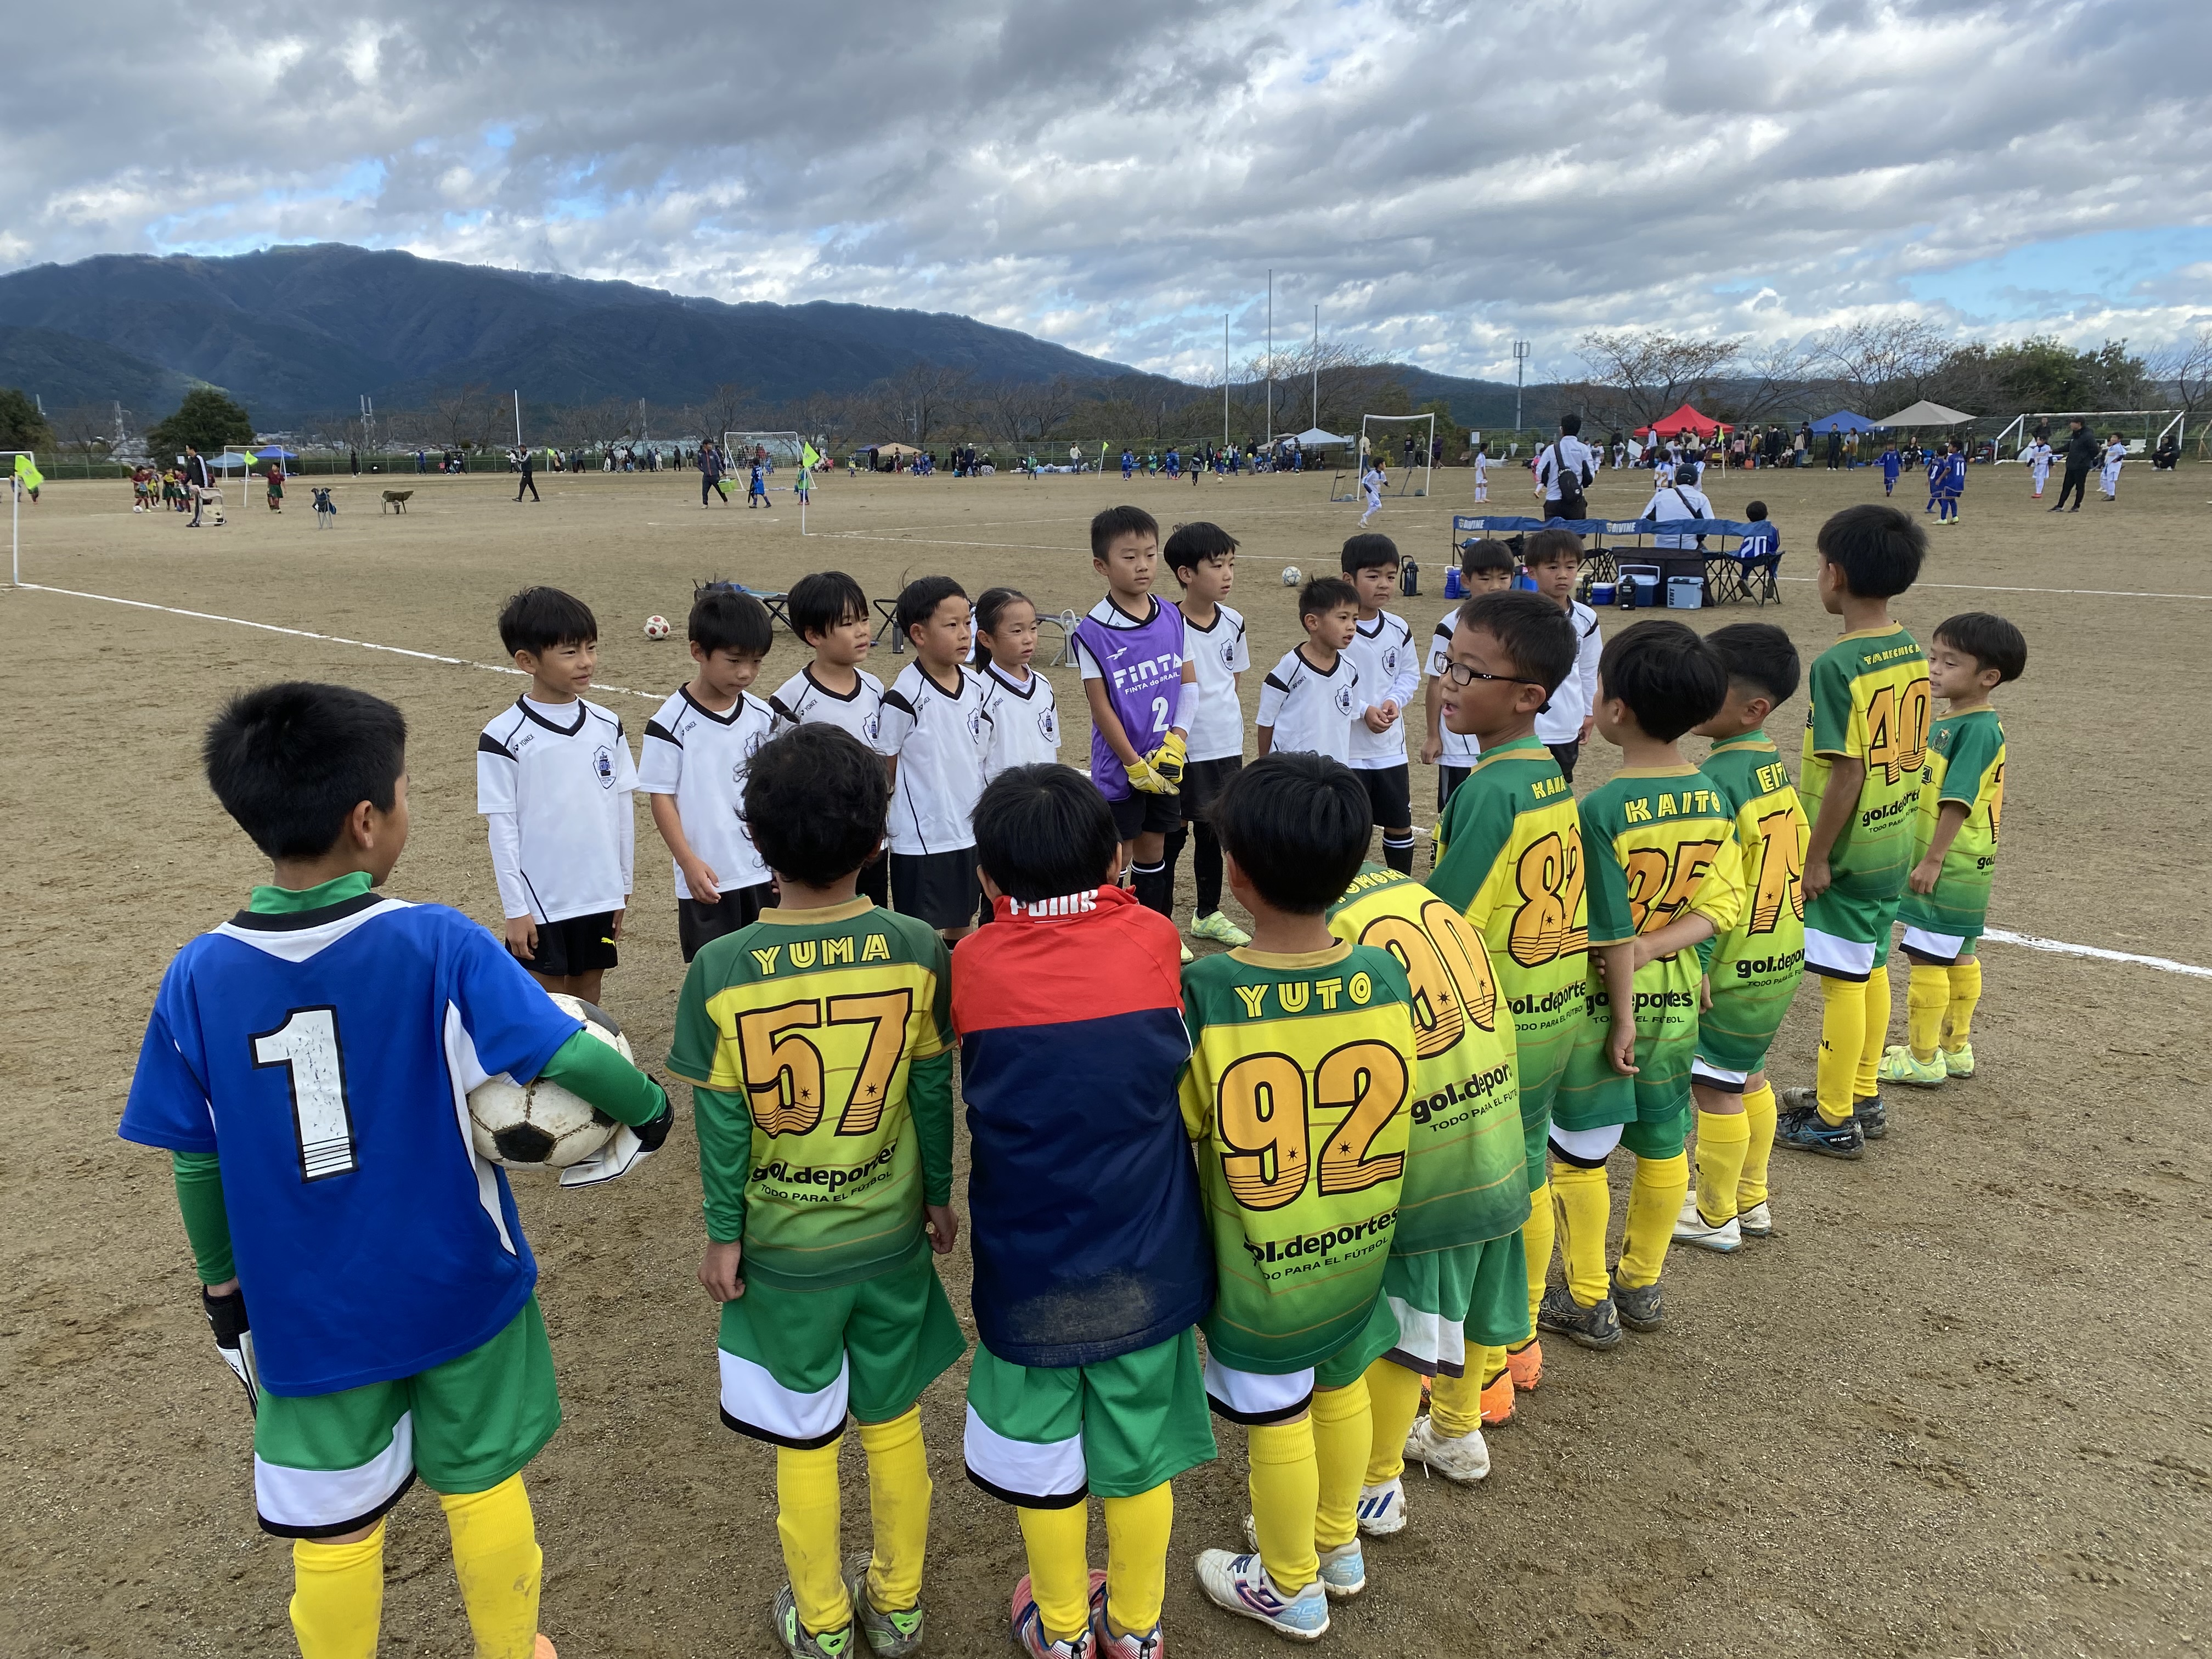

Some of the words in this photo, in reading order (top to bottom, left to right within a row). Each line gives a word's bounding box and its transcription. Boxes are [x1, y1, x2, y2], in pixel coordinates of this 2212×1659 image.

[1956, 461, 1965, 476] 11
[1464, 520, 1485, 529] DIVINE
[1611, 522, 1636, 533] DIVINE
[1741, 535, 1767, 558] 20
[1125, 683, 1148, 695] FINTA
[1160, 672, 1180, 682] BRAIL
[1297, 675, 1307, 686] YONEX
[804, 698, 819, 712] YONEX
[992, 698, 1003, 708] YONEX
[1152, 696, 1169, 732] 2
[519, 733, 535, 747] YONEX
[685, 720, 697, 732] ONEX
[1867, 678, 1931, 786] 40
[1755, 761, 1790, 793] EIT
[1624, 789, 1722, 823] KAITO
[1977, 854, 1995, 870] gol.
[1508, 823, 1588, 969] 82
[751, 934, 891, 975] YUMA
[1234, 972, 1371, 1018] YUTO
[1359, 899, 1496, 1059] 90
[1515, 1023, 1537, 1031] ODO
[1541, 1018, 1559, 1029] PARA
[735, 988, 913, 1139] 57
[248, 1004, 359, 1184] 1
[1217, 1039, 1408, 1211] 92
[1430, 1113, 1469, 1132] TODO
[1471, 1102, 1492, 1118] PARA
[1493, 1097, 1503, 1107] EL
[761, 1183, 788, 1198] TODO
[792, 1192, 830, 1202] PARA
[833, 1193, 848, 1201] EL
[851, 1171, 891, 1195] FÚTBOL
[1244, 1204, 1399, 1262] ol.deportes
[1285, 1261, 1321, 1276] PARA
[1324, 1257, 1341, 1266] EL
[1345, 1236, 1389, 1261] FÚTBOL
